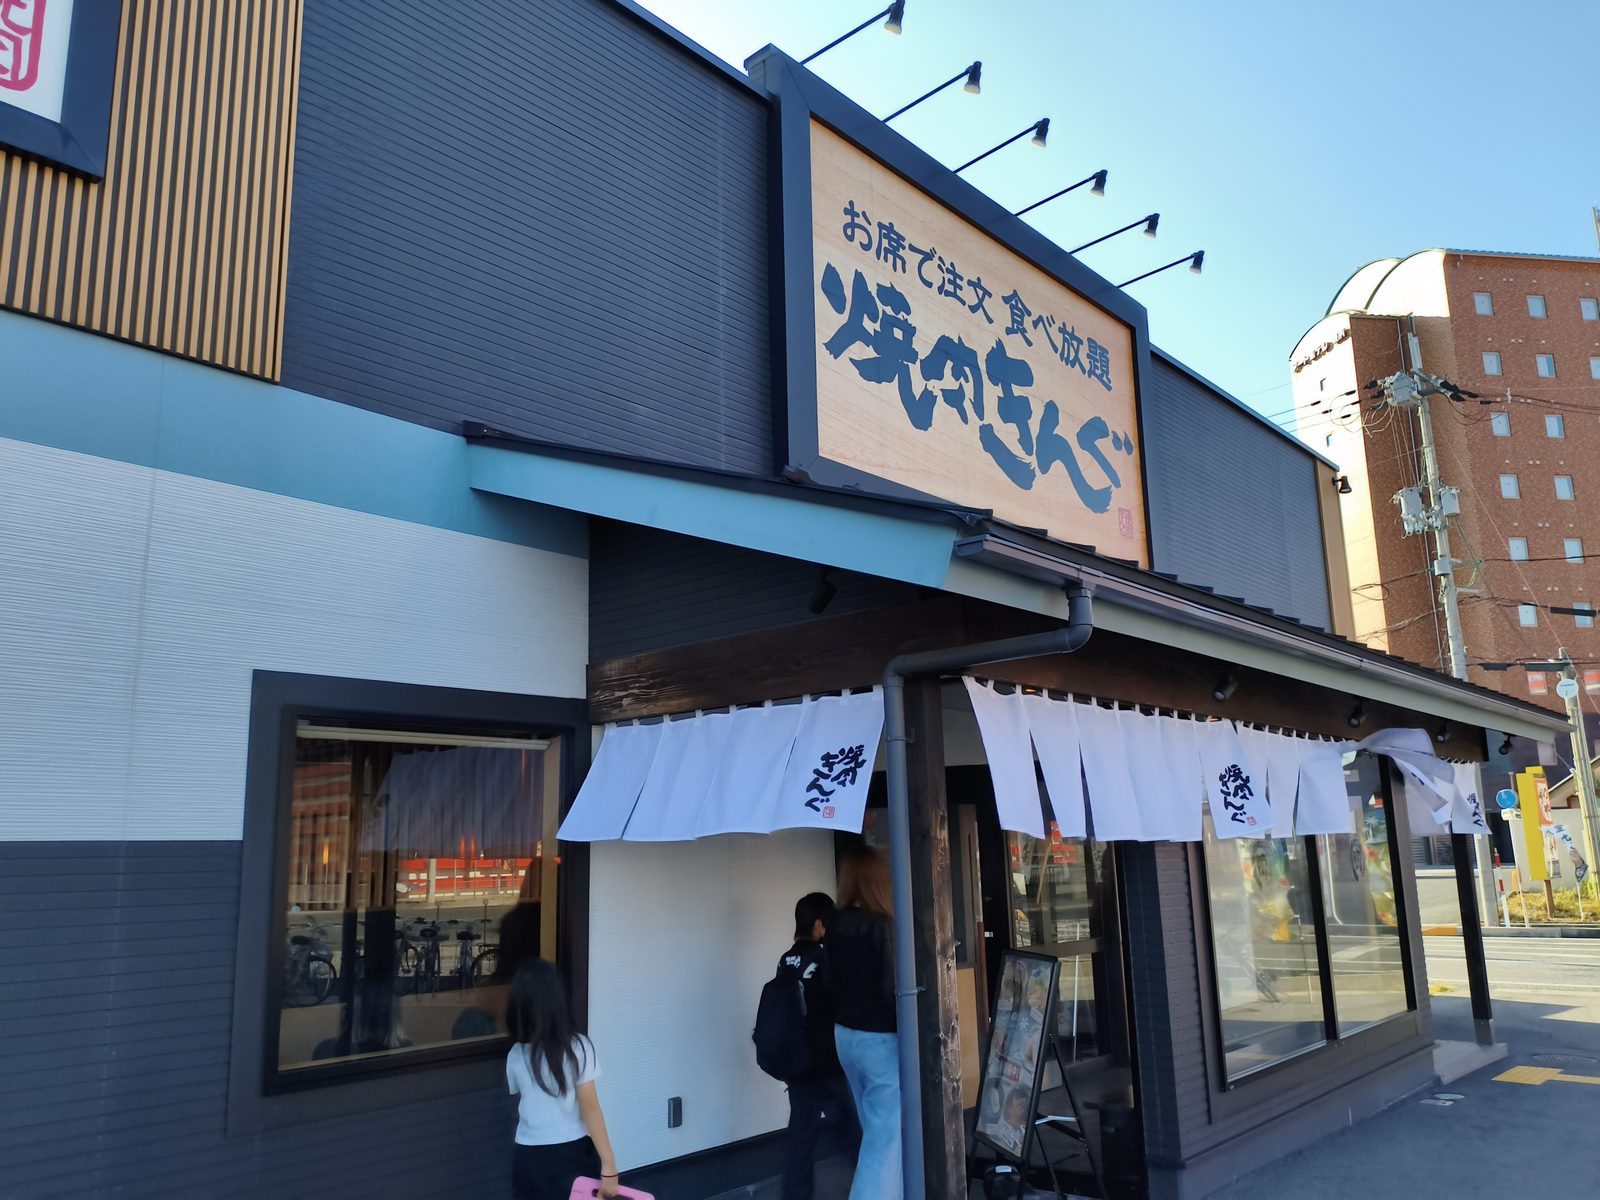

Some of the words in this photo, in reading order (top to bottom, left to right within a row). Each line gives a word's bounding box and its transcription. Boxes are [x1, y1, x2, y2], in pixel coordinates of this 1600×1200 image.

[820, 261, 1134, 514] 焼肉きんぐ
[842, 200, 994, 325] お席で注文
[1001, 289, 1113, 391] 食べ放題
[804, 752, 840, 812] きんぐ
